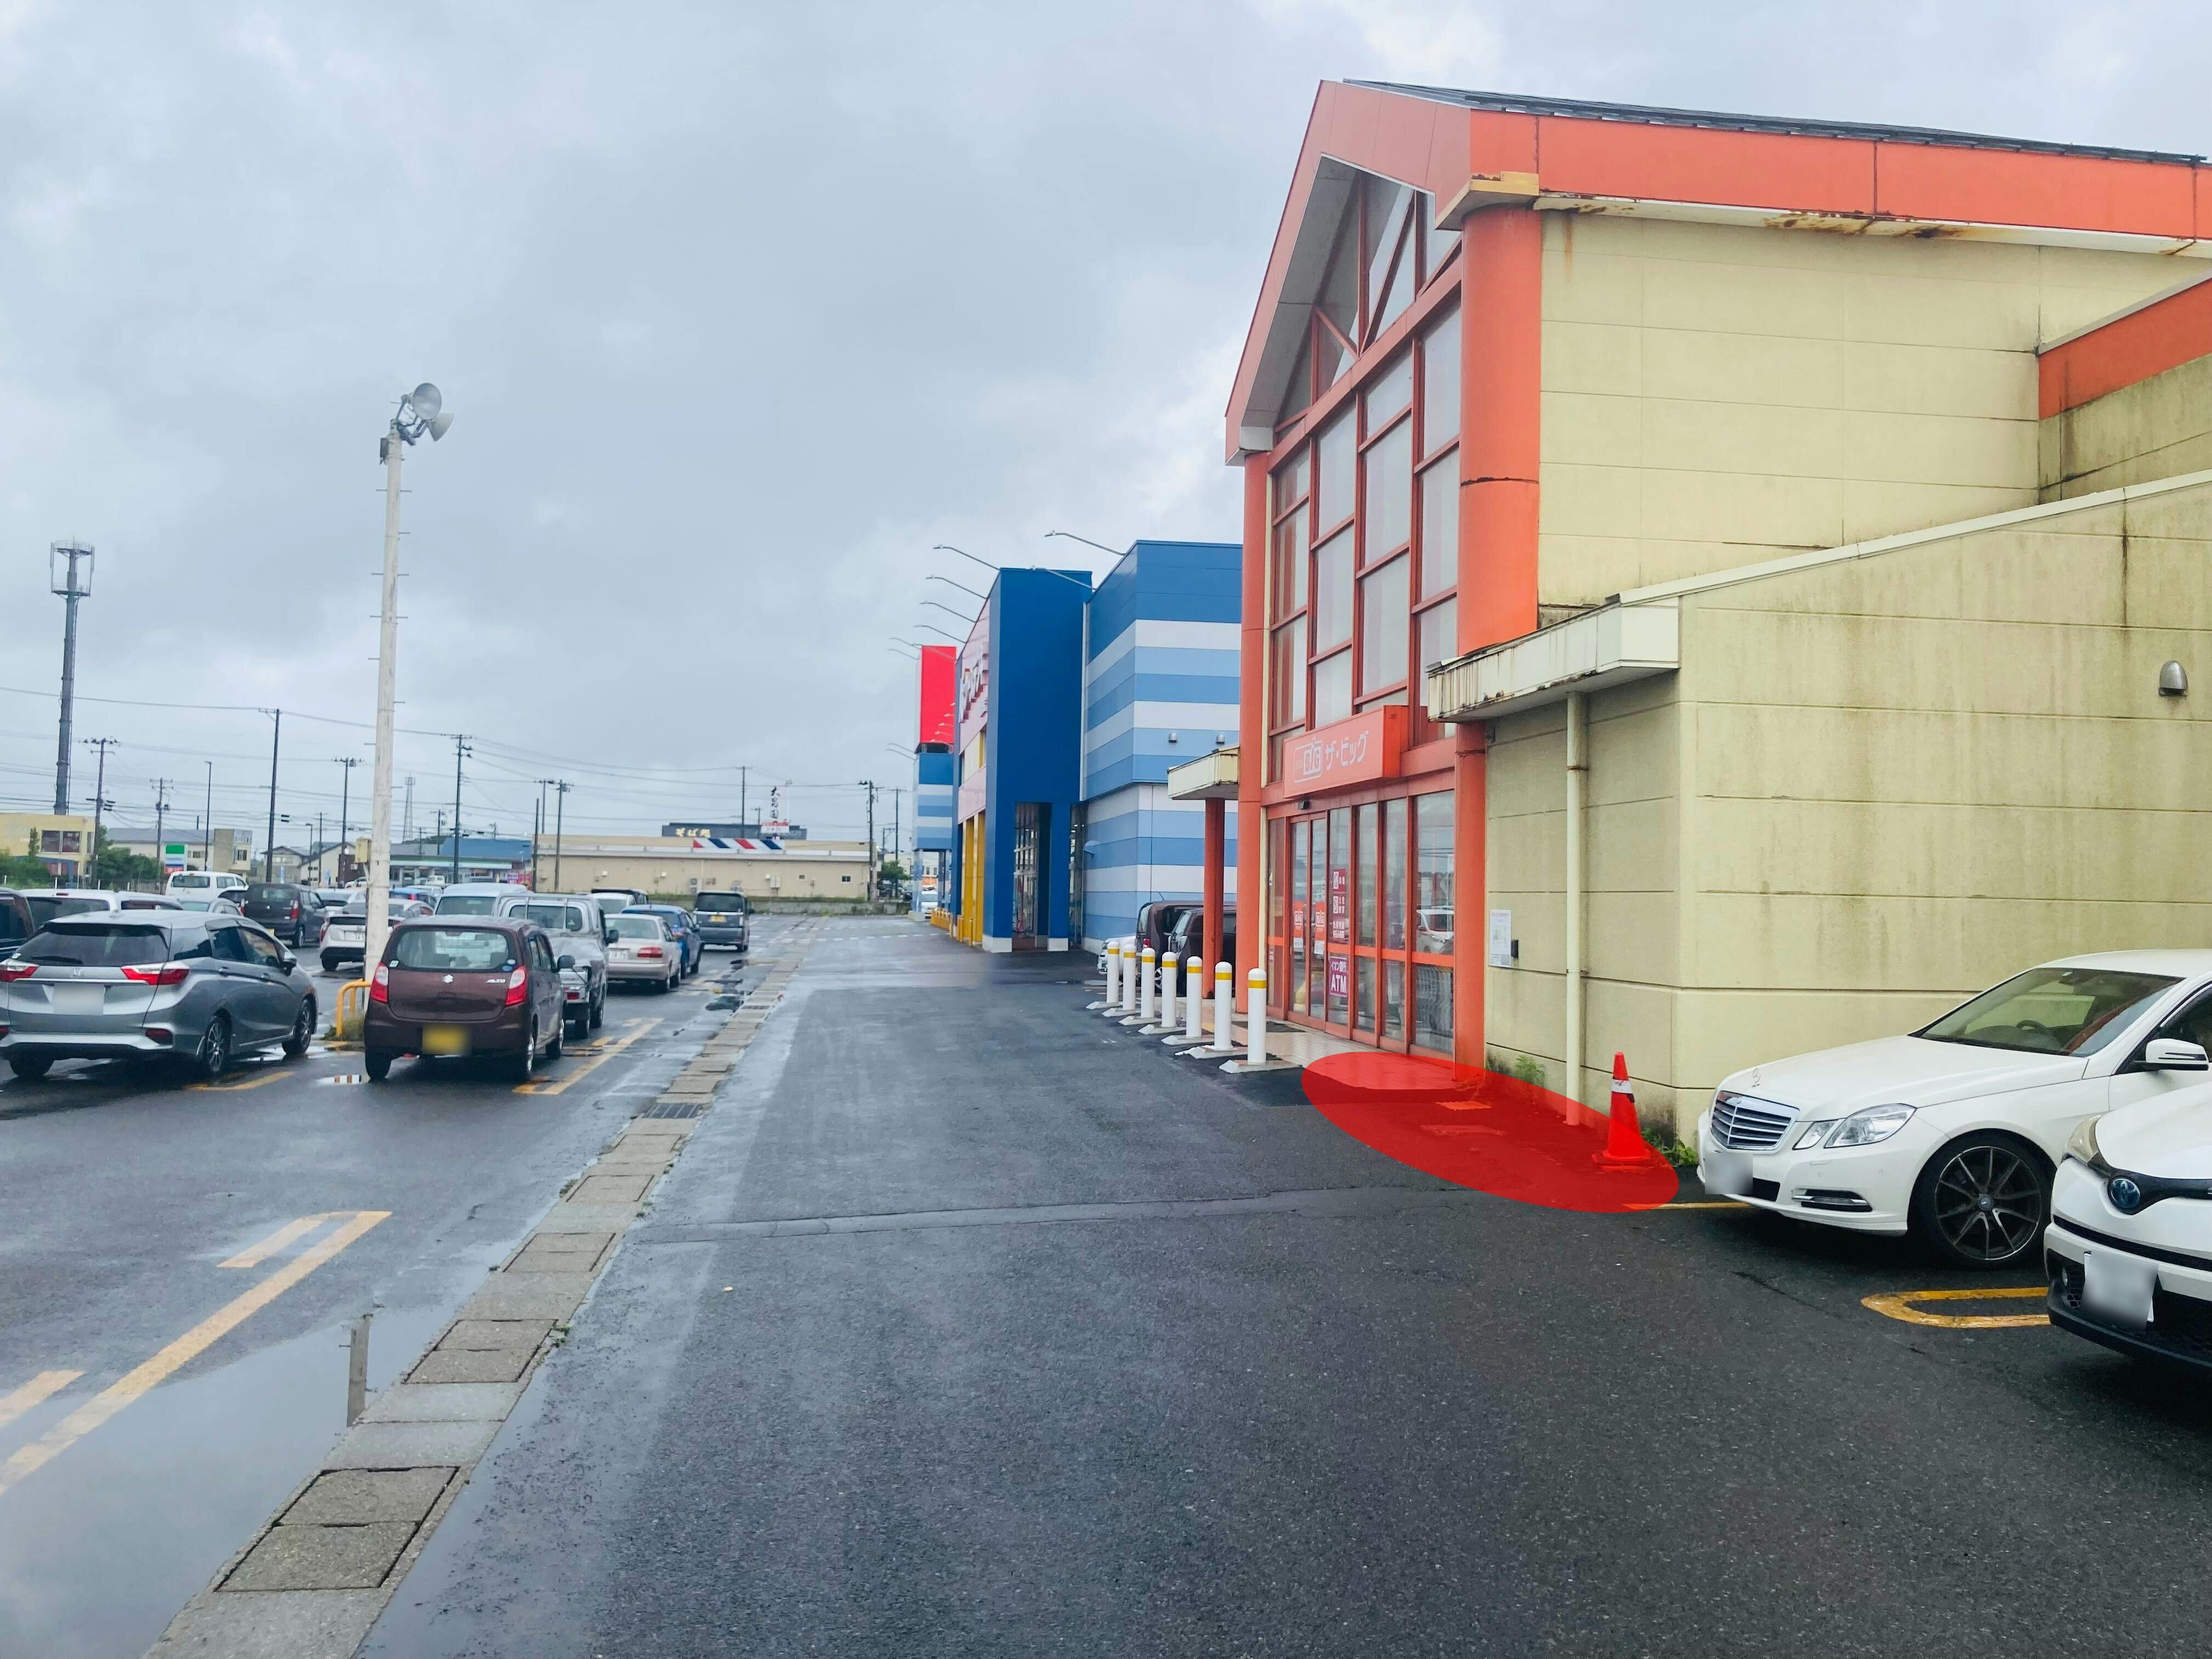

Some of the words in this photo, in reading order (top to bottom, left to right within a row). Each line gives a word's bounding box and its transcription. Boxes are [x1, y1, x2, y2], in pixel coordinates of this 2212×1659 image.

[1325, 730, 1369, 770] ザ・ビッグ
[1331, 974, 1346, 993] ATM
